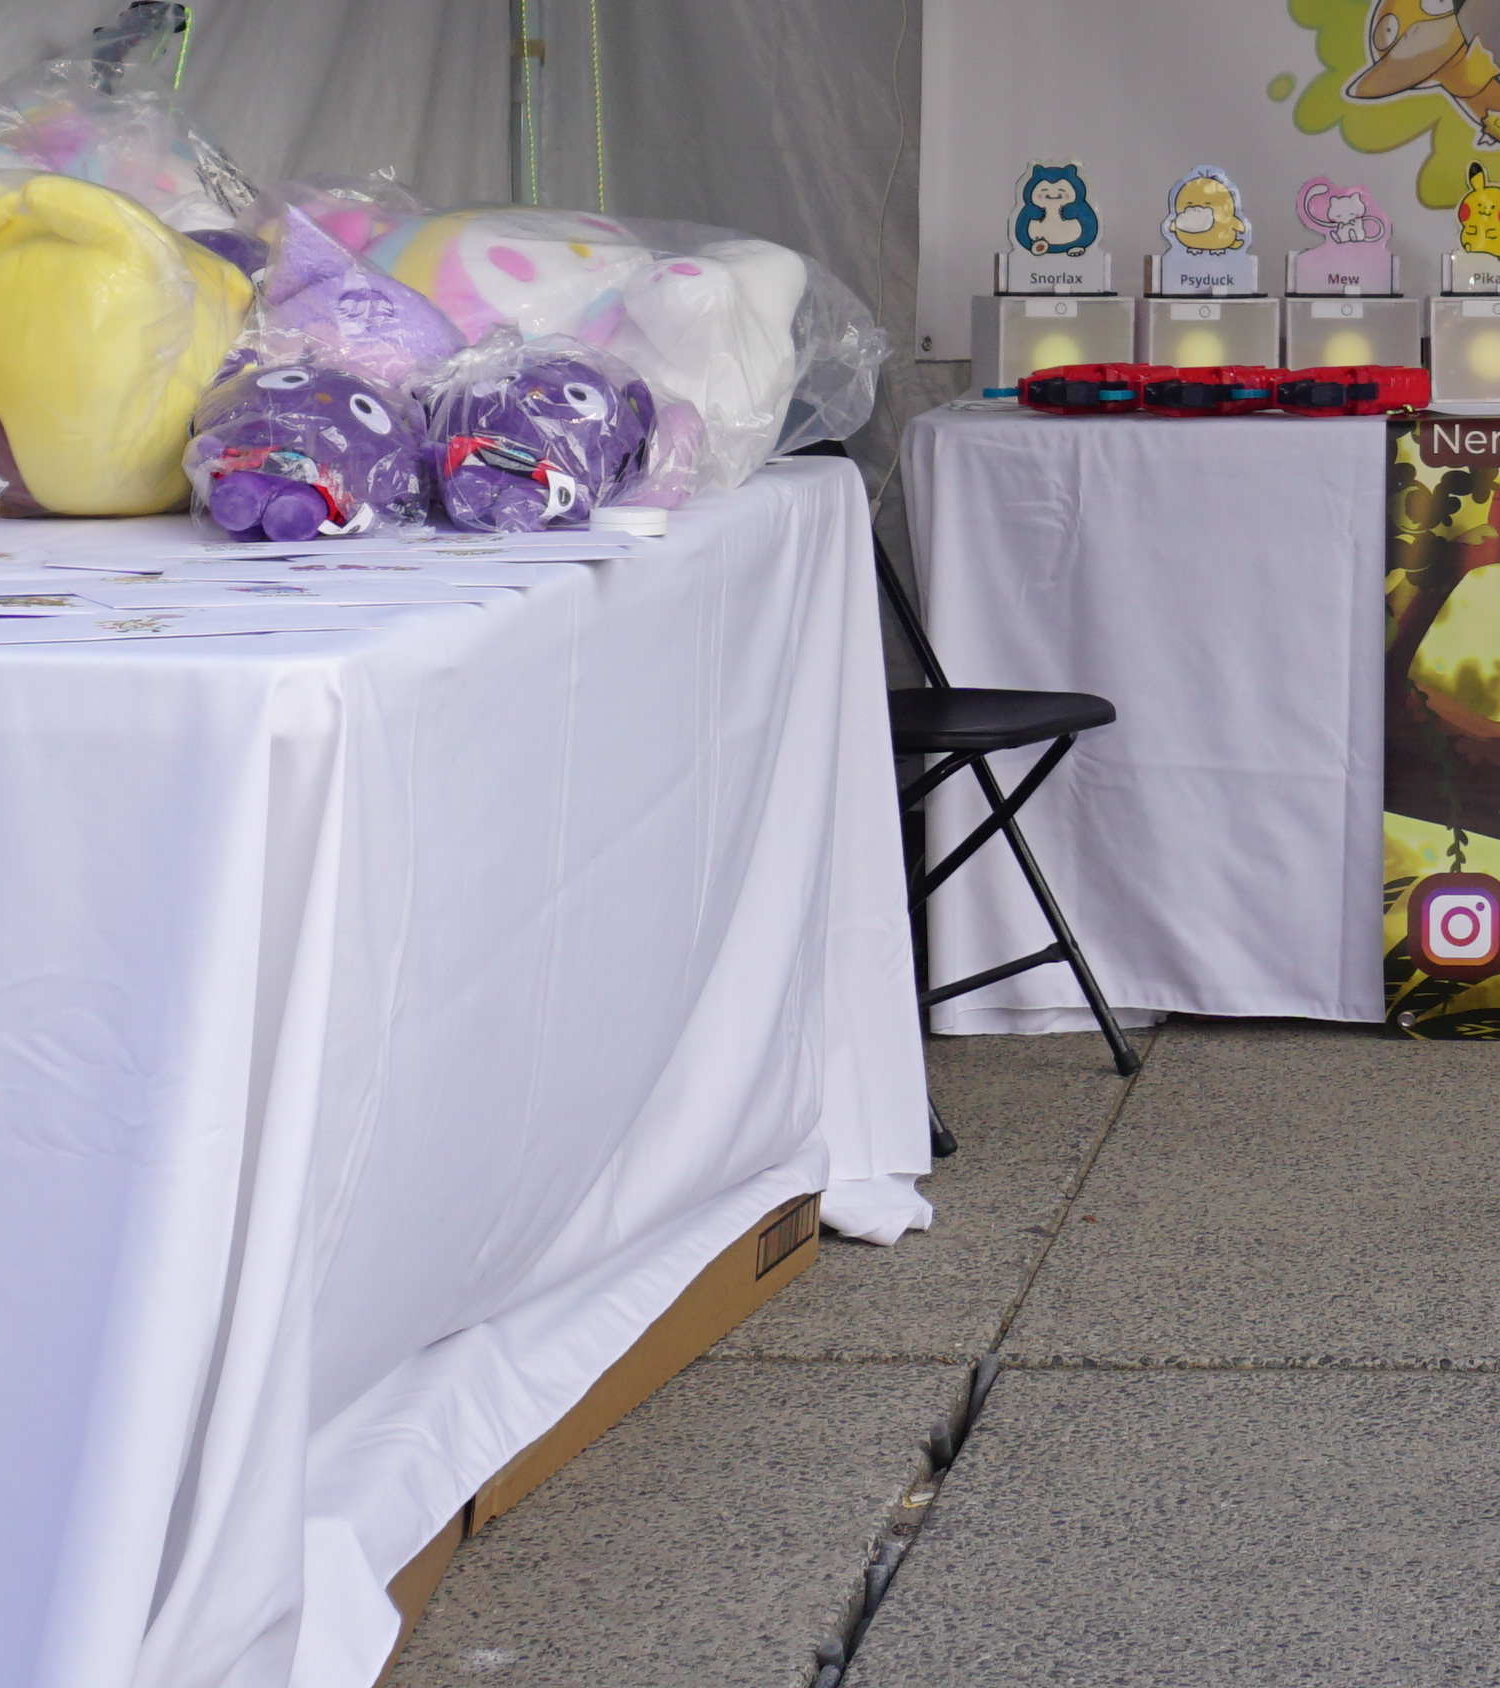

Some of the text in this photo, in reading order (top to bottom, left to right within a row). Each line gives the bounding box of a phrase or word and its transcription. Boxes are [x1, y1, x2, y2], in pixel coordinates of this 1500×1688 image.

[1029, 272, 1083, 287] Snorlax
[1180, 273, 1234, 290] Psyduck
[1327, 273, 1360, 285] Mew
